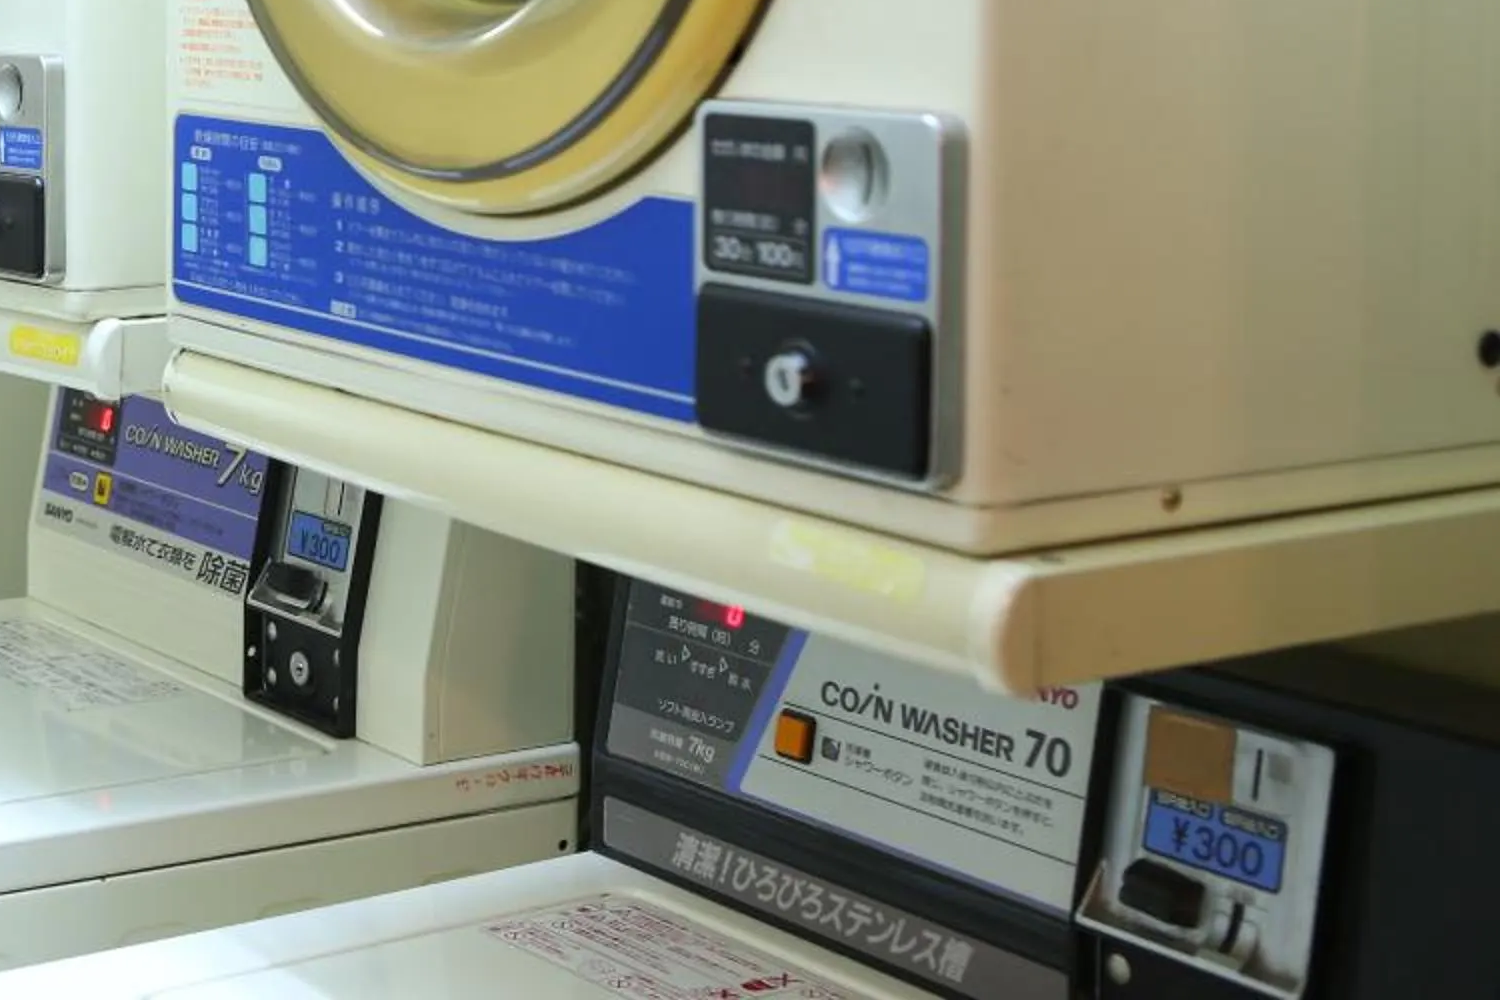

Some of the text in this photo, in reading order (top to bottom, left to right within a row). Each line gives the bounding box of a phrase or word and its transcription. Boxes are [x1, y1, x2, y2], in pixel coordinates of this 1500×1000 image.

[125, 424, 164, 450] COIN
[165, 436, 221, 470] WASHER
[45, 502, 73, 523] SANYO
[197, 551, 251, 595] 除菌
[820, 681, 1072, 778] COIN WASHER 70
[1171, 816, 1265, 878] ¥300
